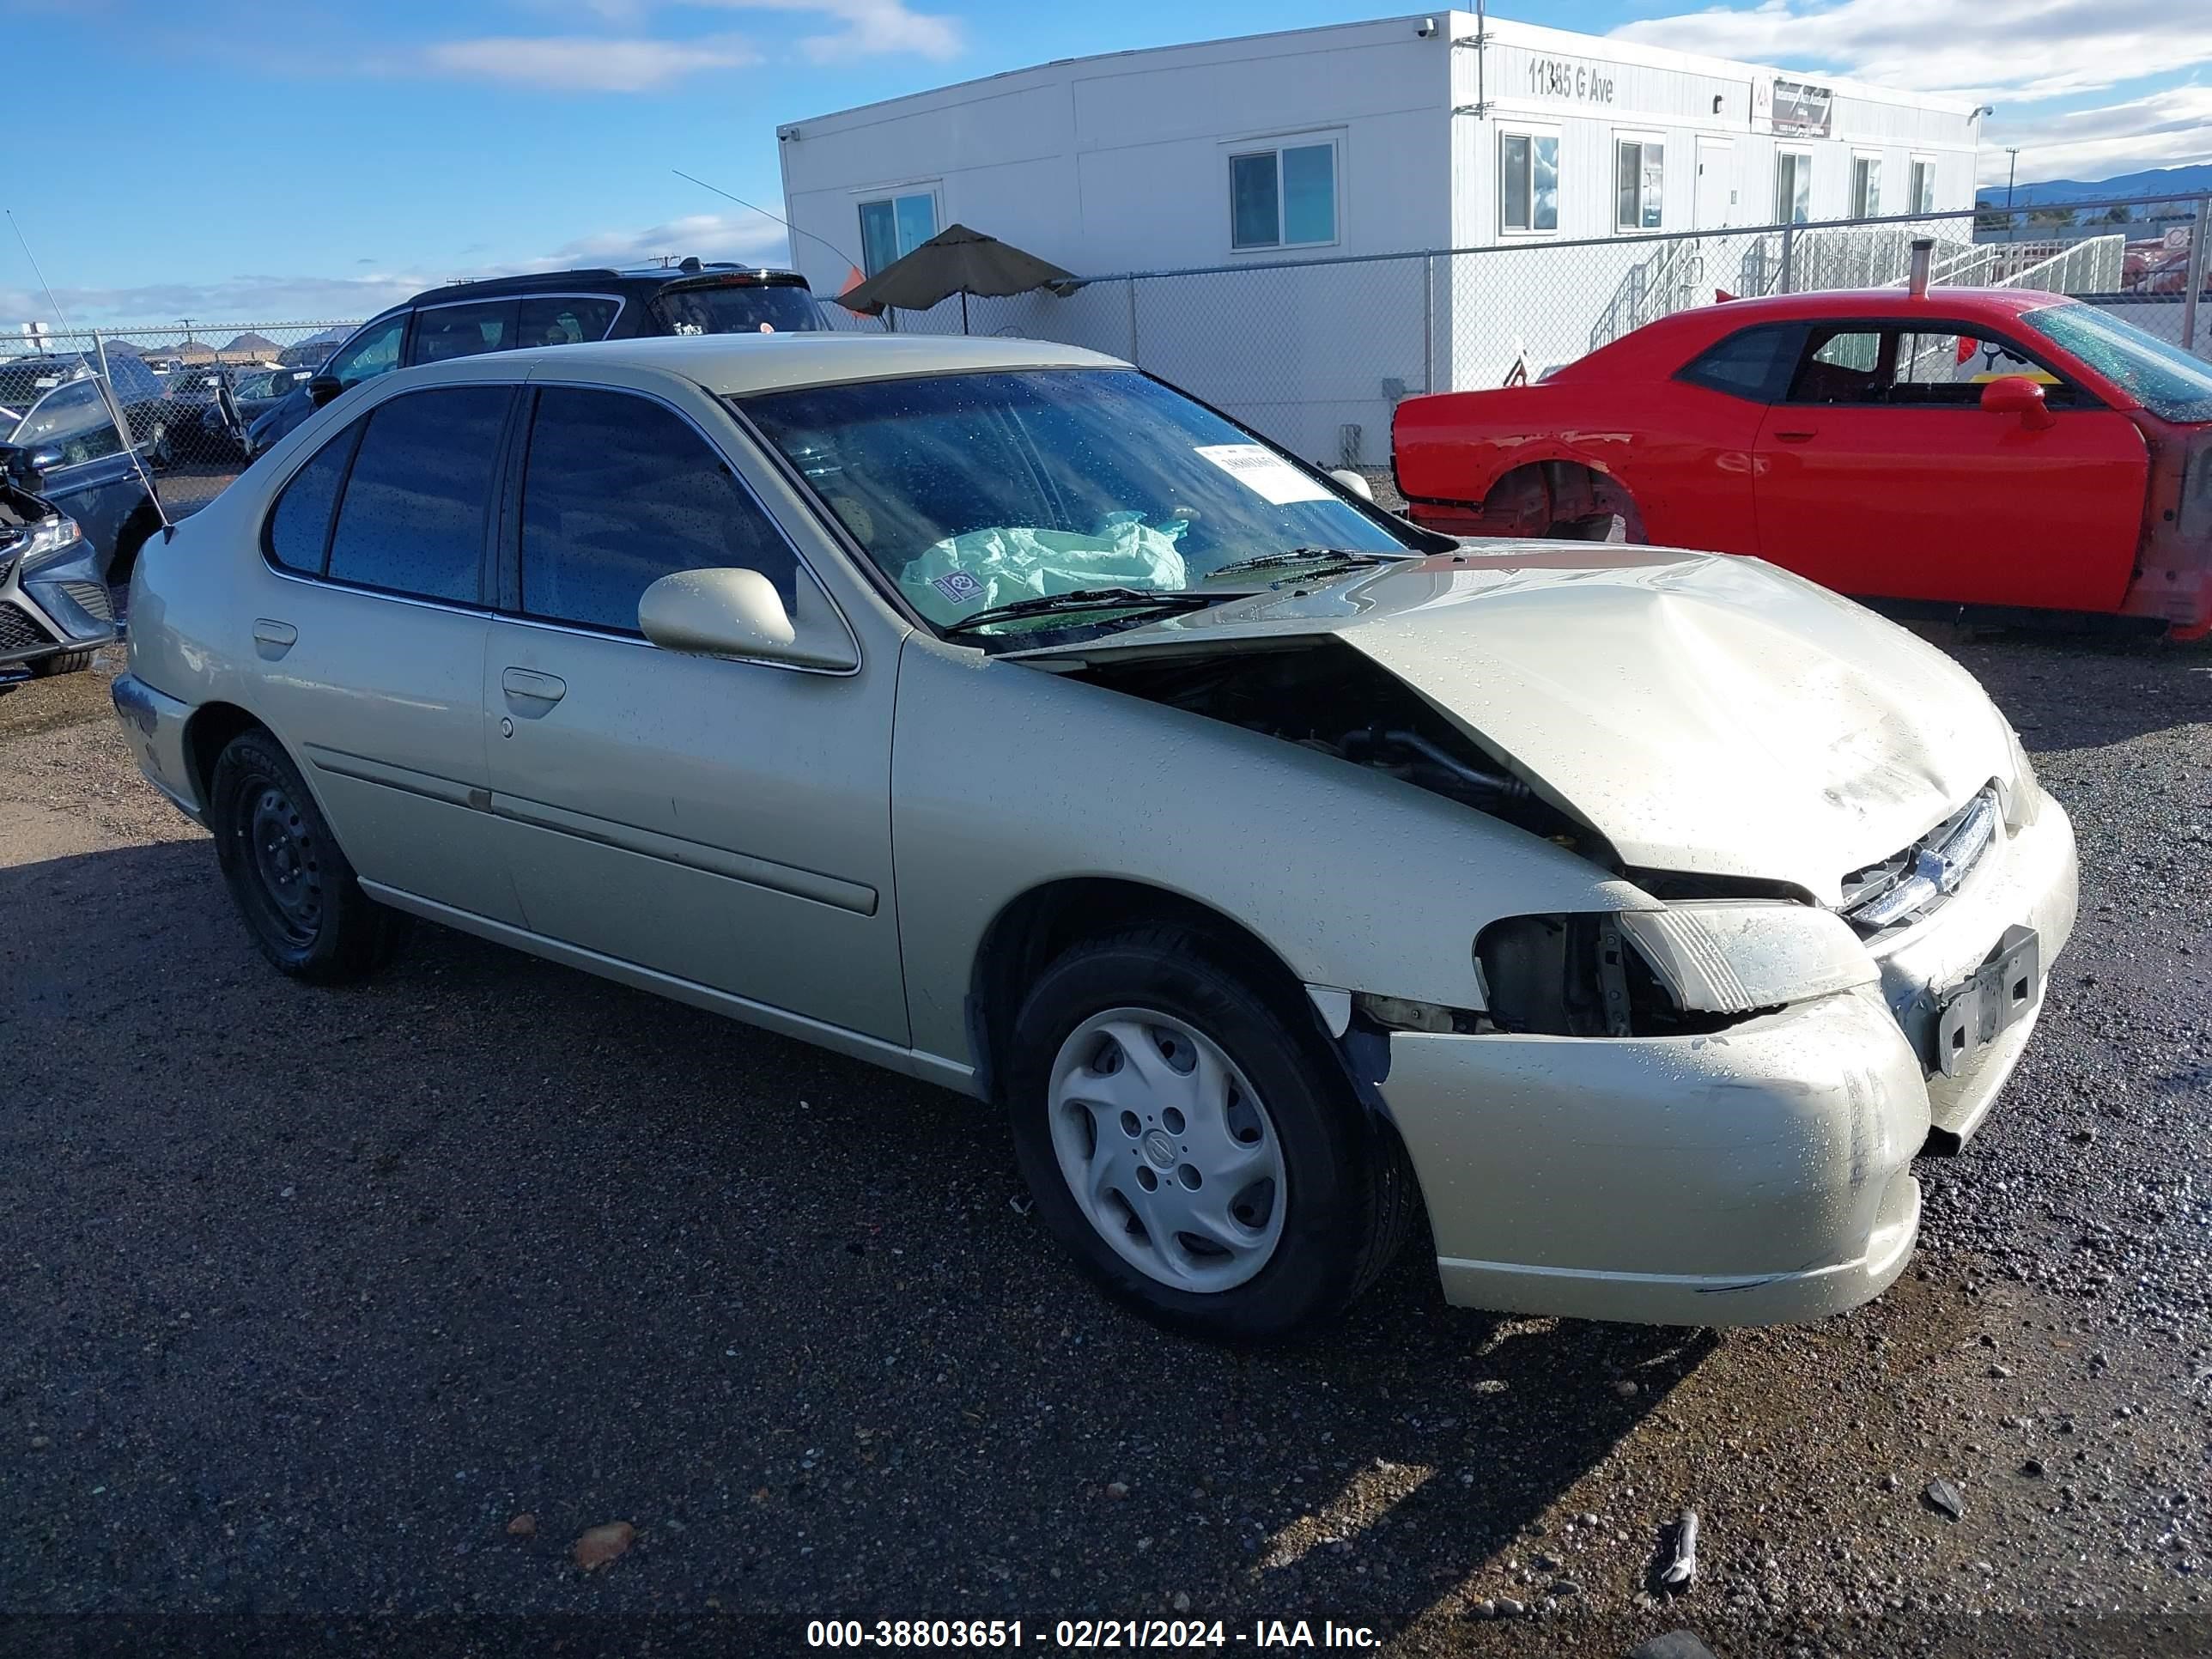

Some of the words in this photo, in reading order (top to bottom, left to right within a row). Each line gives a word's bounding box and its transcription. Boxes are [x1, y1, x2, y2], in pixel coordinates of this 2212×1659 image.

[1528, 58, 1571, 99] 11385
[1576, 66, 1586, 100] G
[1589, 69, 1613, 104] Ave
